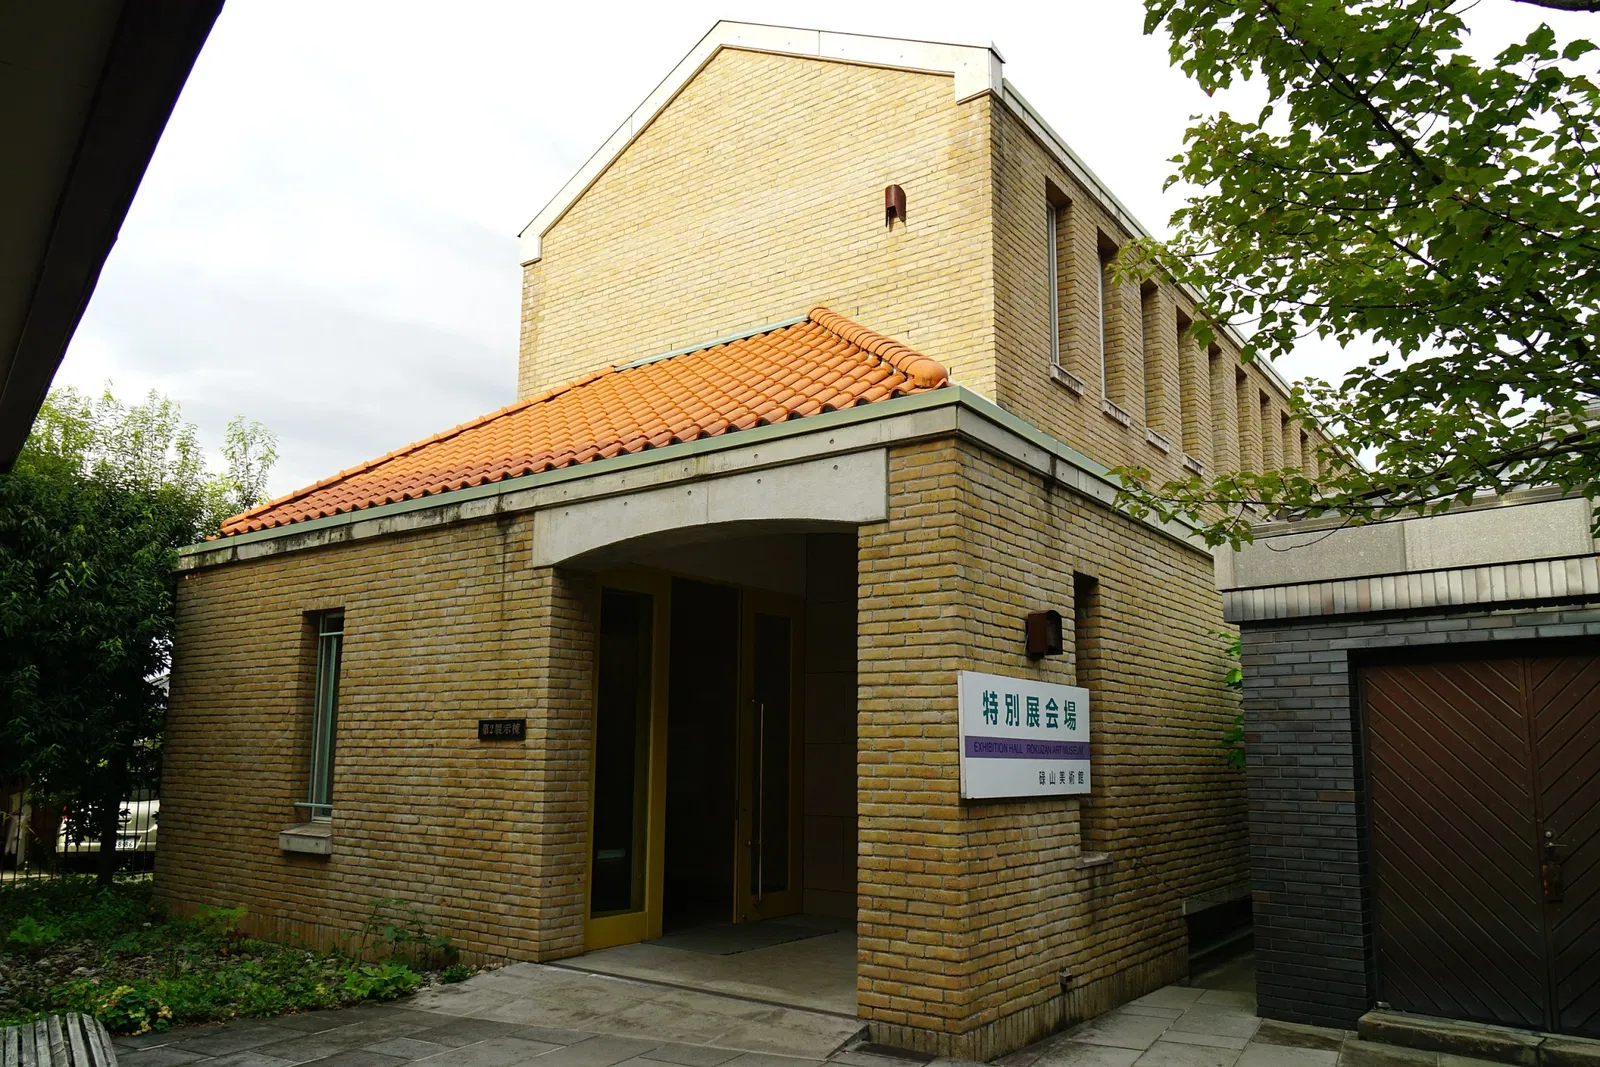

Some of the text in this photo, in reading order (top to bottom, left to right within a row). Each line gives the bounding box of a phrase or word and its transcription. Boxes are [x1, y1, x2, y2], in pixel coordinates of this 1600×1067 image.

[982, 690, 1077, 731] 特別展会場
[973, 741, 1084, 756] EXHIBITION HALL ROKUZAN ART MUSEUM
[1038, 770, 1084, 785] 碌山美術館
